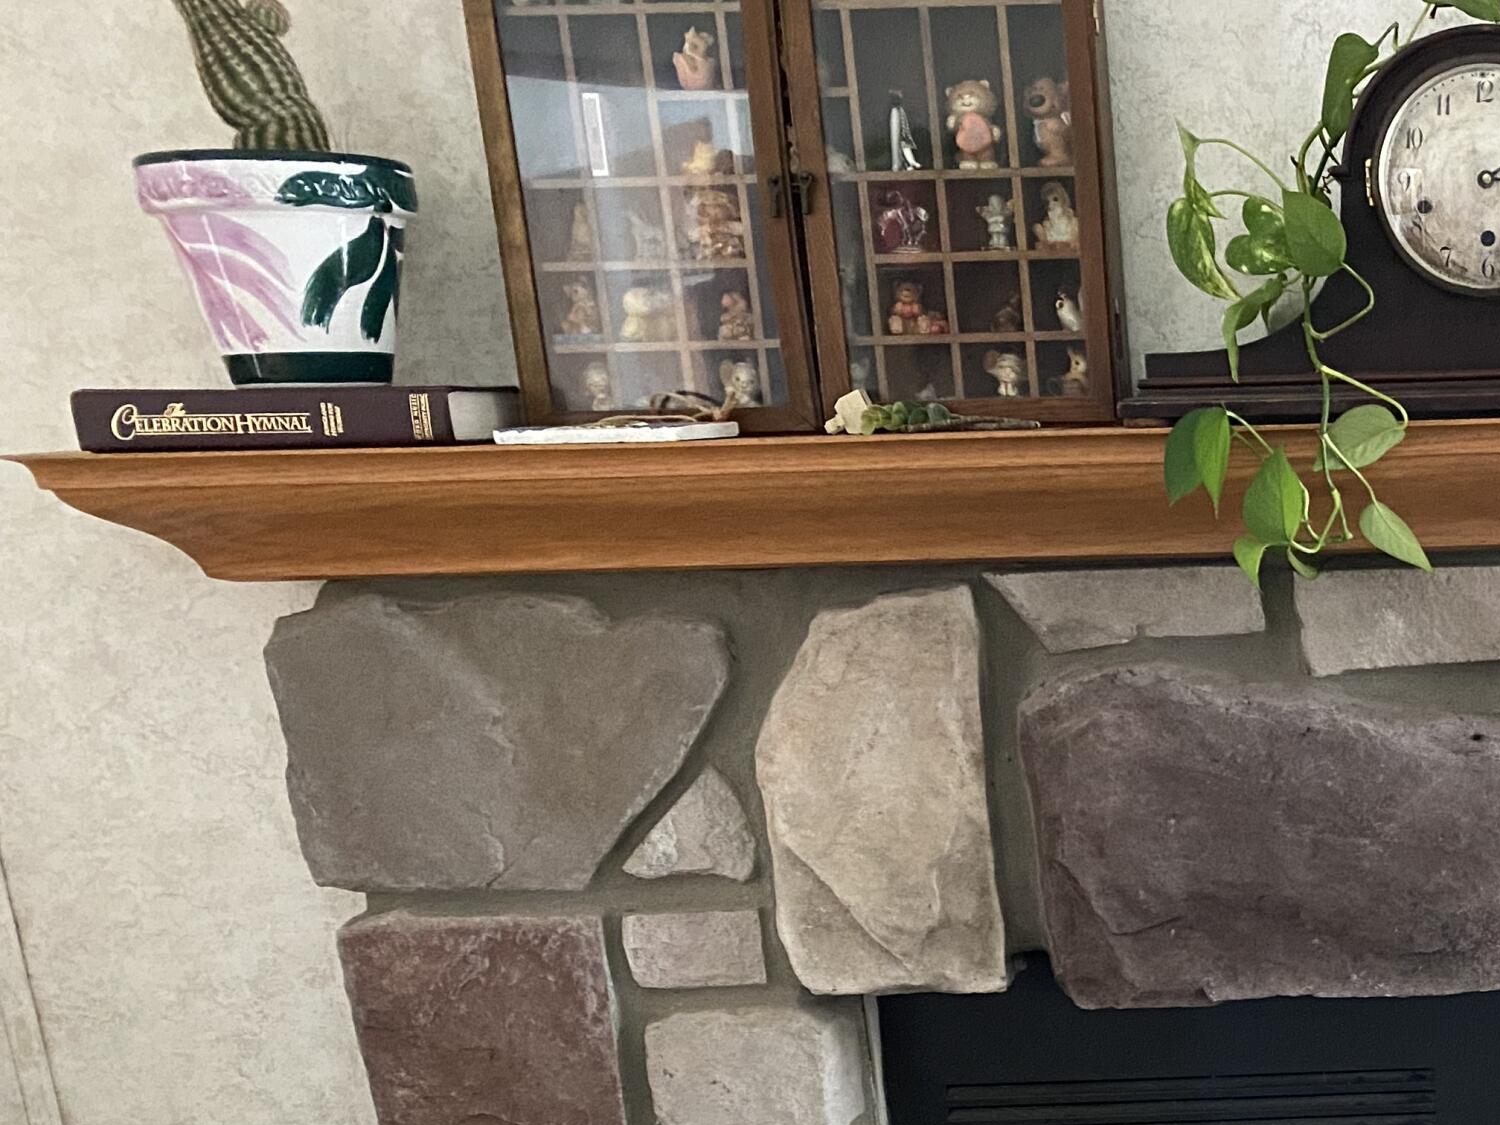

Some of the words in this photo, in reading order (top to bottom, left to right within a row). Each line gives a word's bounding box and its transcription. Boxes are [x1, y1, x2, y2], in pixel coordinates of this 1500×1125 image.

[1476, 80, 1494, 103] 12
[1436, 94, 1451, 116] 11
[1406, 126, 1424, 149] 10
[1398, 171, 1411, 191] 9
[1440, 246, 1452, 268] 7
[1482, 257, 1495, 279] 6
[111, 404, 236, 441] CELEBRATION
[236, 413, 313, 434] HYMNAL
